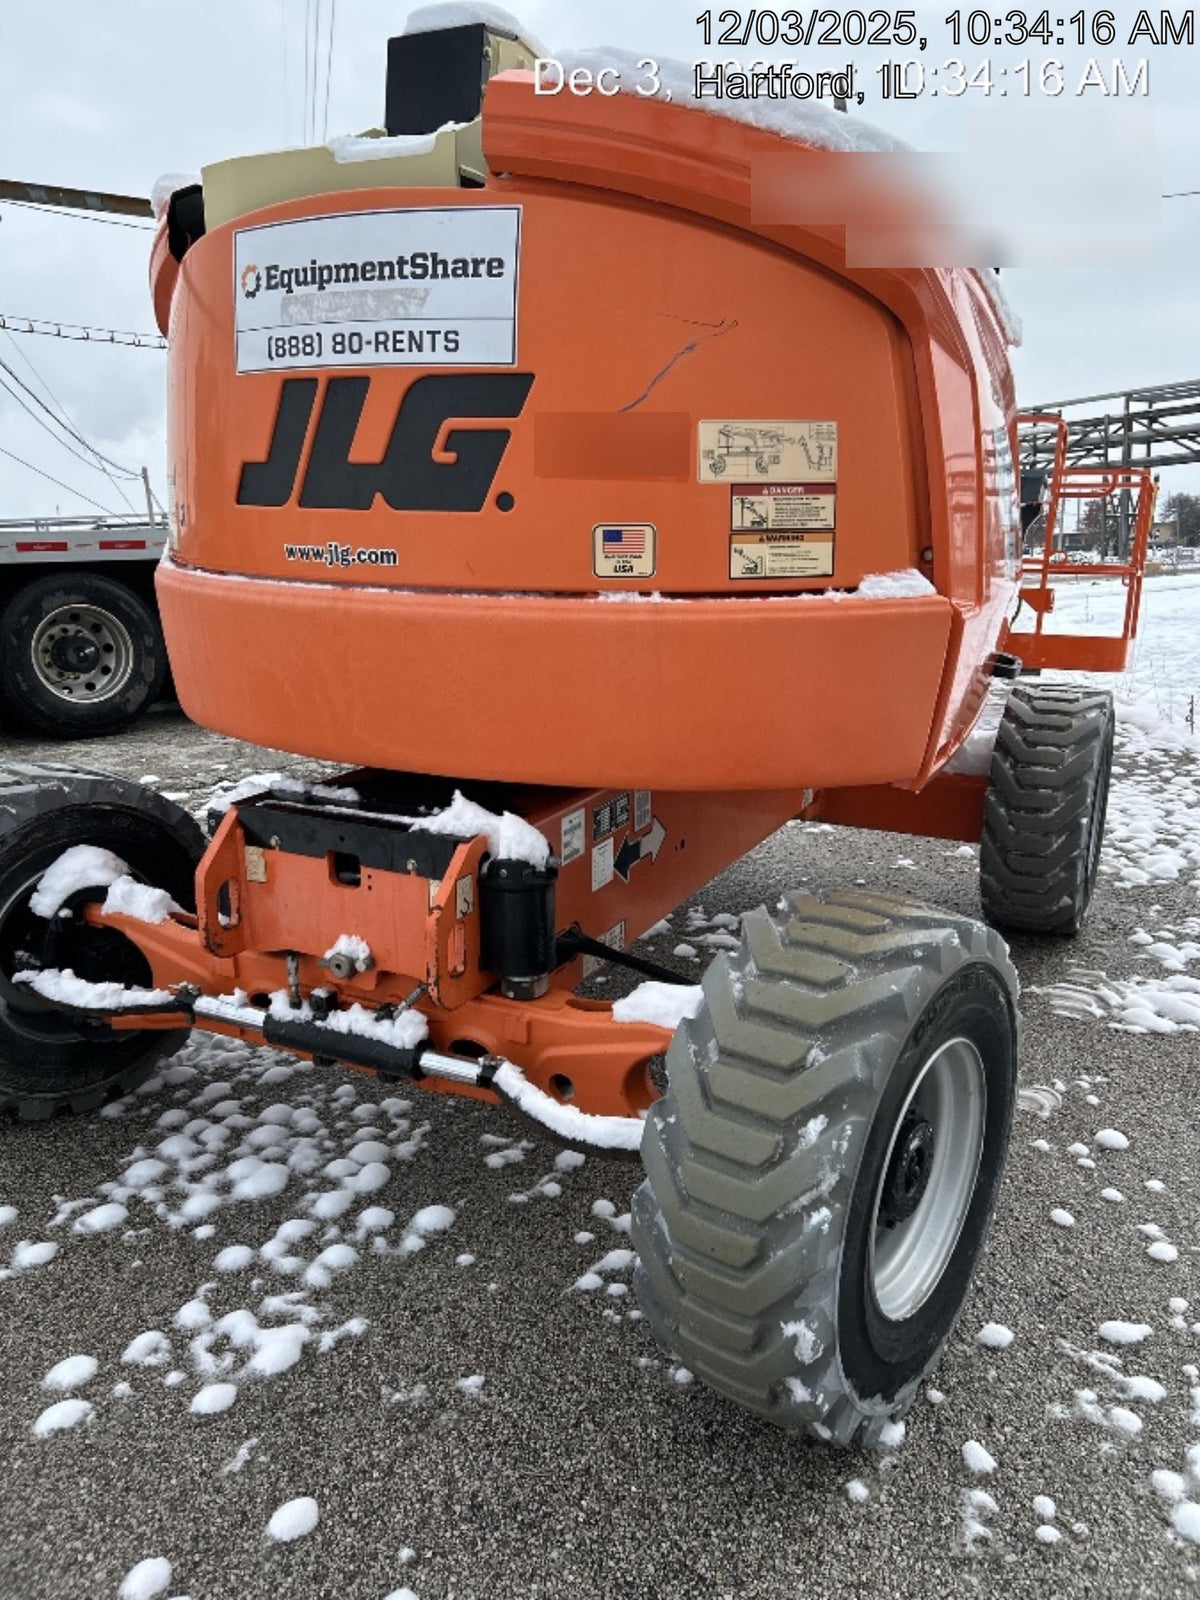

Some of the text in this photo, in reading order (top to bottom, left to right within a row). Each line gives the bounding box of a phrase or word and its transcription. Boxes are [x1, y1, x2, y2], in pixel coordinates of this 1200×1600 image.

[265, 252, 505, 293] EquipmentShare
[268, 330, 460, 361] (888) 80-RENTS
[284, 543, 399, 568] www.jlg.com
[613, 564, 634, 573] USA
